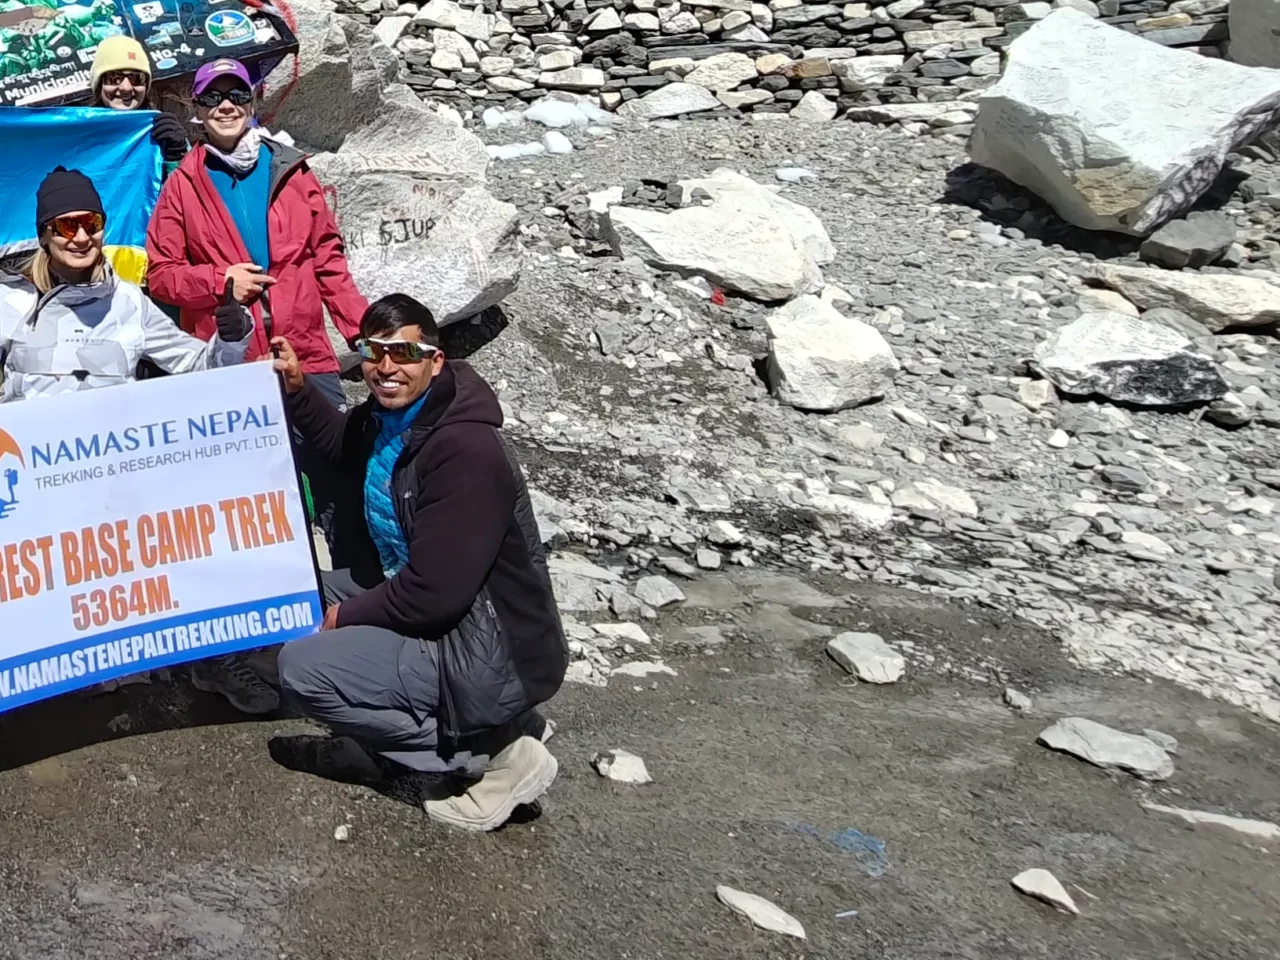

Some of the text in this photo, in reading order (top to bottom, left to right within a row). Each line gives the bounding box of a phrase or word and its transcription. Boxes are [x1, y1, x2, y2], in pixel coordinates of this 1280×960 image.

[4, 69, 92, 101] Municipalit
[30, 404, 279, 469] NAMASTE NEPAL
[34, 434, 282, 490] TREKKING & RESEARCH HUB PVT. LTD.
[60, 519, 134, 586] BASE
[137, 504, 216, 569] CAMP
[218, 490, 295, 551] TREK
[71, 574, 180, 631] 5364M.
